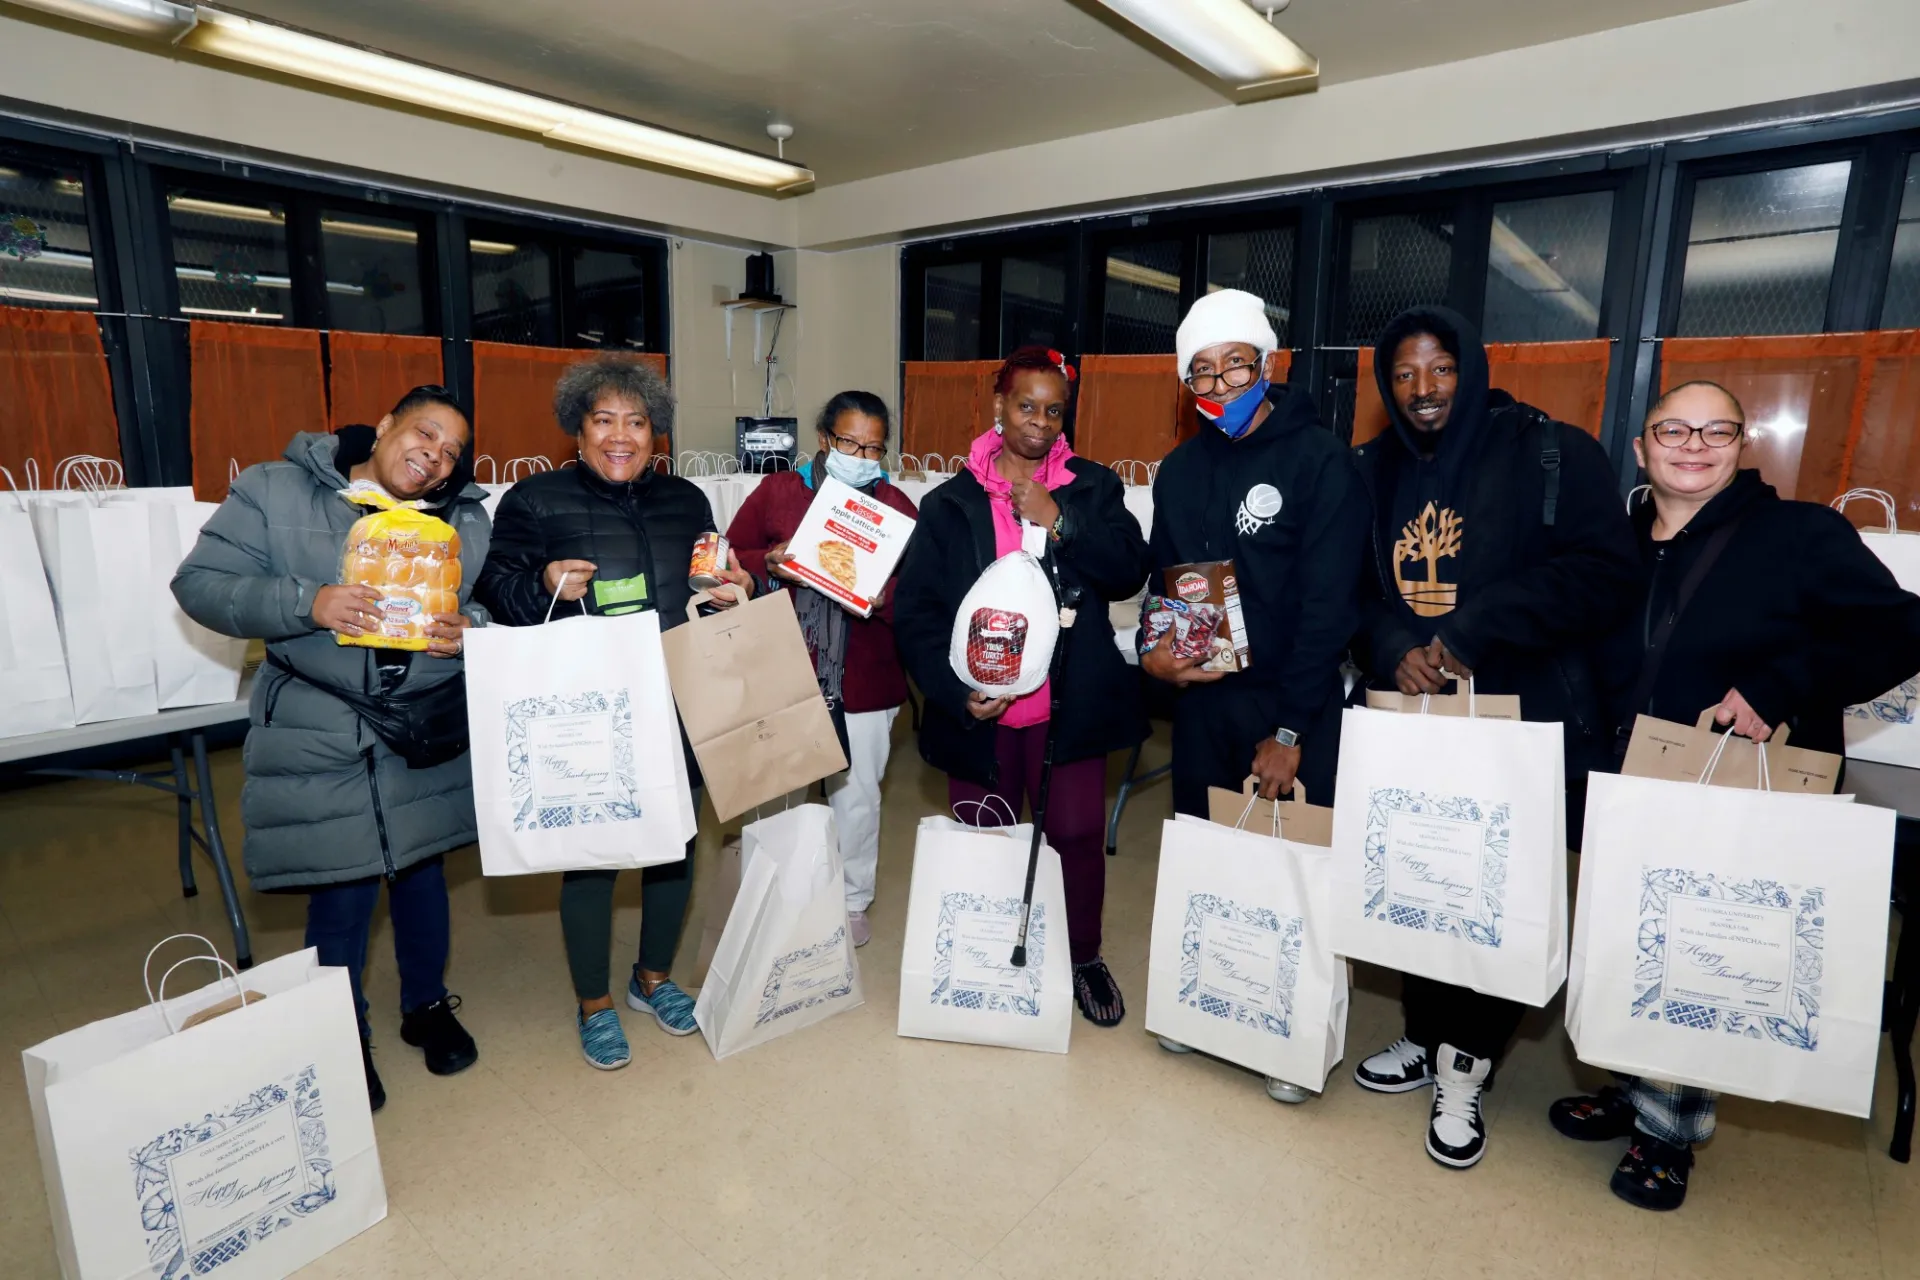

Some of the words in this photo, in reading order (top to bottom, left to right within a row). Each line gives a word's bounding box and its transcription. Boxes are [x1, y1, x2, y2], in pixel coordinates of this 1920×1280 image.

[851, 503, 877, 521] Classic
[859, 495, 878, 511] Sysco
[831, 505, 852, 520] Apple
[851, 516, 875, 533] Lattice
[875, 528, 887, 539] Pie
[1179, 580, 1207, 594] IDAHOAN
[982, 651, 1005, 661] TURKEY
[986, 642, 1004, 653] YOUNG
[1392, 850, 1429, 874] Happy
[1415, 872, 1473, 898] Thanksgiving
[1734, 935, 1762, 945] NYCHA
[1673, 940, 1725, 967] Happy
[1702, 965, 1783, 995] Thanksgiving
[245, 1142, 270, 1159] NYCHA
[183, 1178, 239, 1208] Happy
[221, 1165, 297, 1210] Thanksgiving
